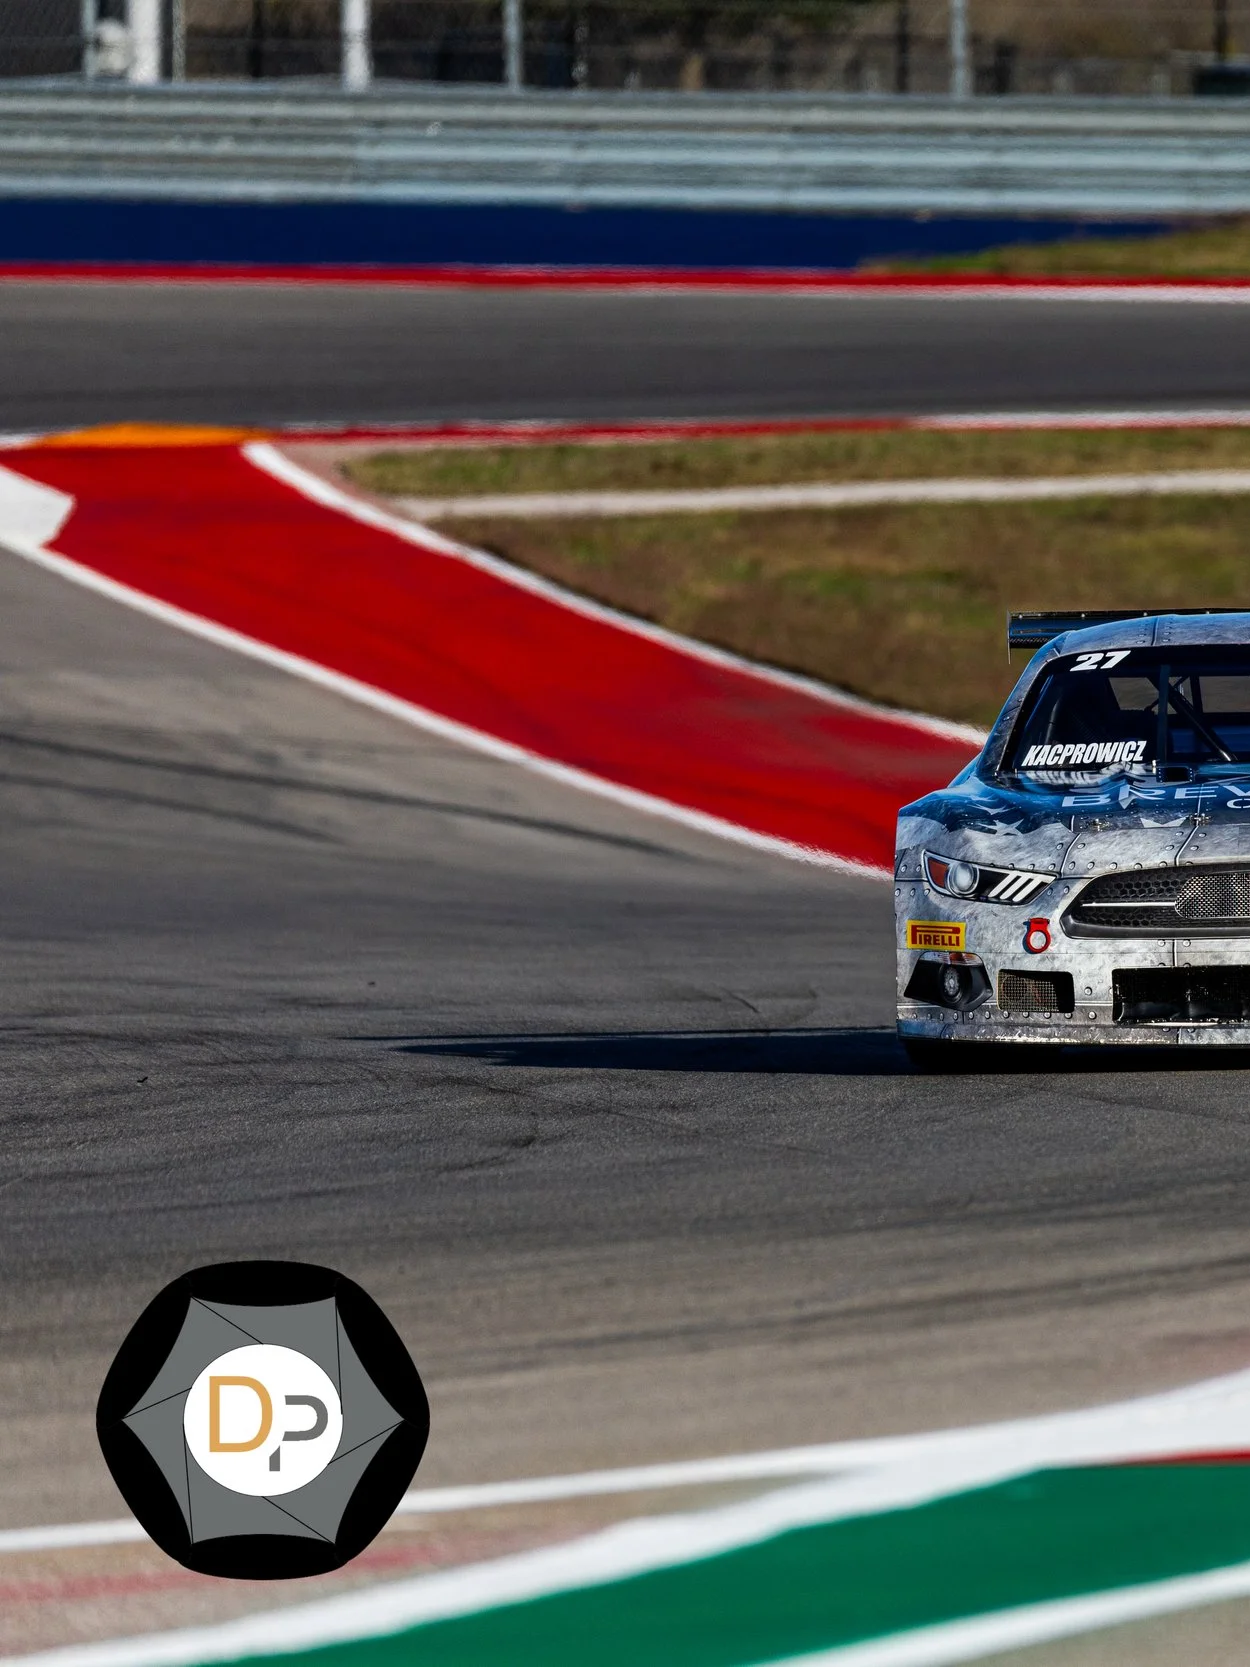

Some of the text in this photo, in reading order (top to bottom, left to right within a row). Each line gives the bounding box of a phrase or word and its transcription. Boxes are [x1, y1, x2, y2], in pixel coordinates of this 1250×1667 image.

[1069, 650, 1132, 672] 27
[1021, 740, 1147, 767] KACPROWICZ
[911, 925, 961, 947] PIRELLI
